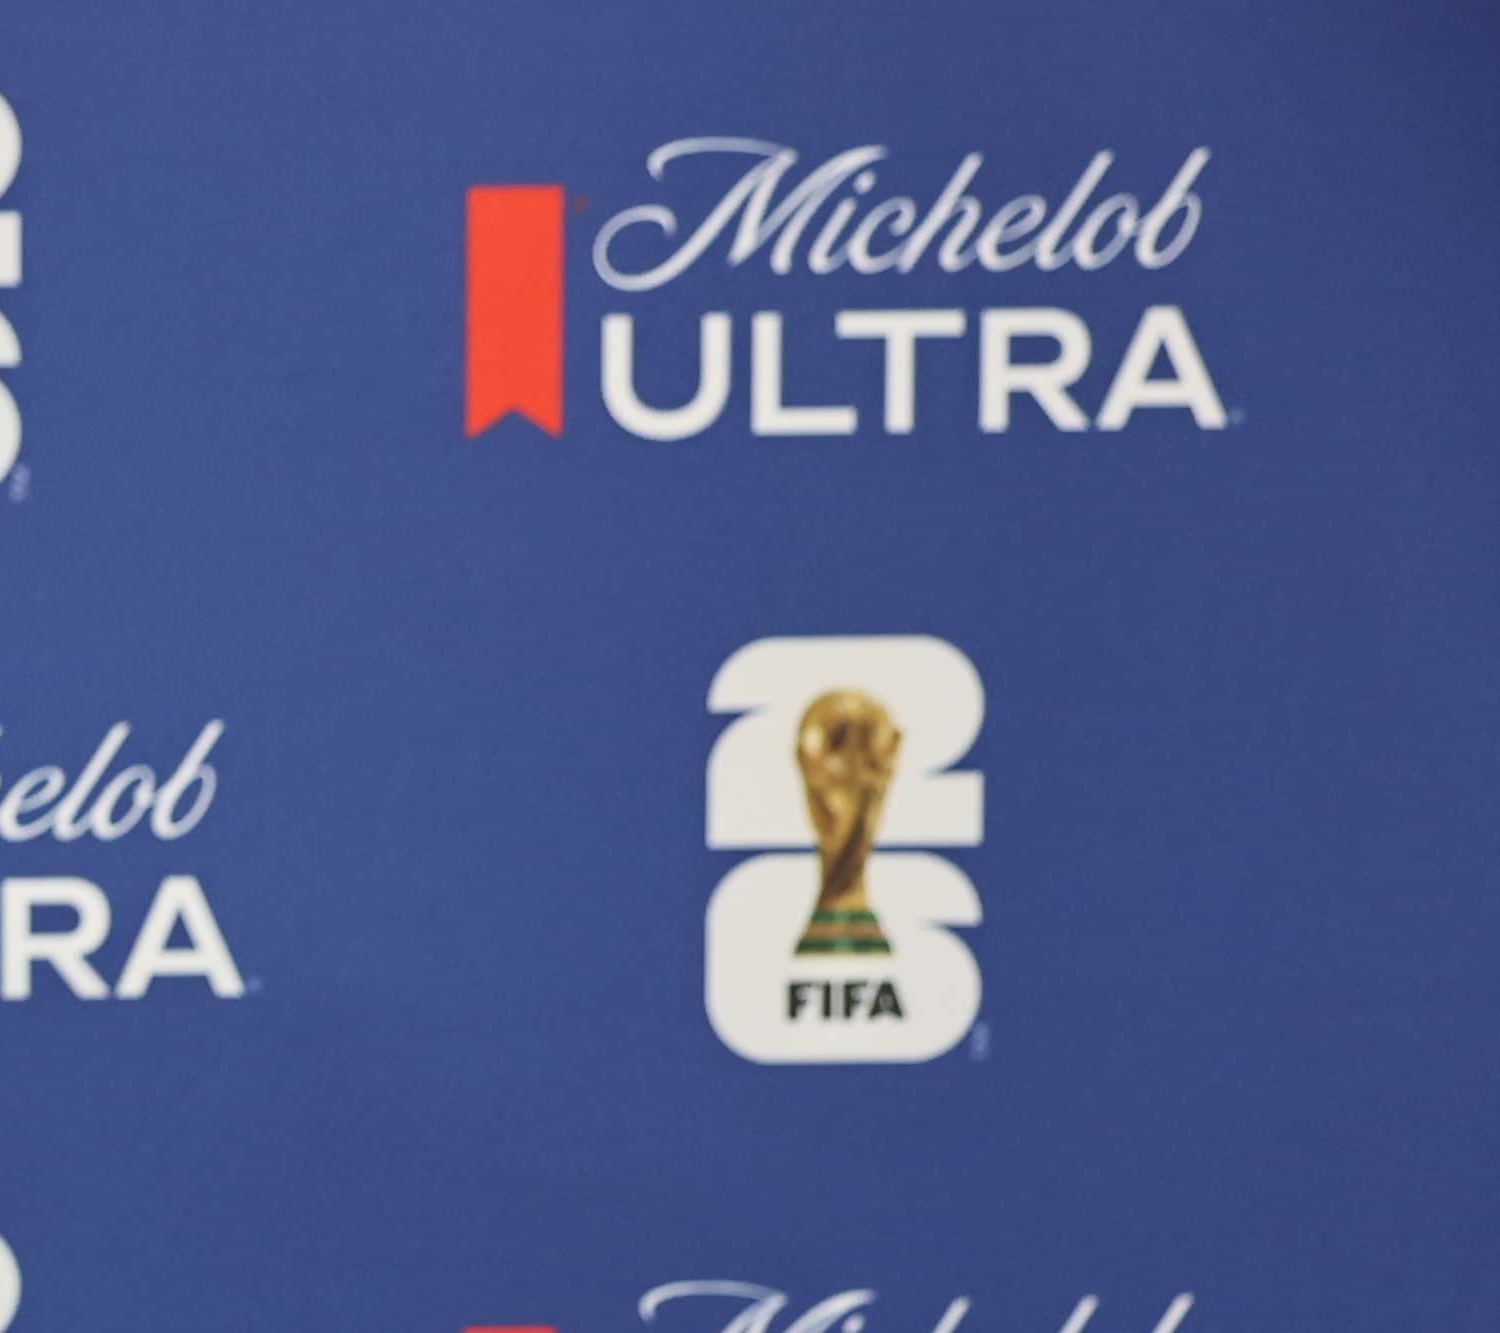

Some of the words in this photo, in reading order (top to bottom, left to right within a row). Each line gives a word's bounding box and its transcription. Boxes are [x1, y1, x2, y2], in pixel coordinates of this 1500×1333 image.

[594, 140, 1207, 290] Michelob
[602, 307, 1225, 439] ULTRA
[789, 982, 902, 1019] FIFA
